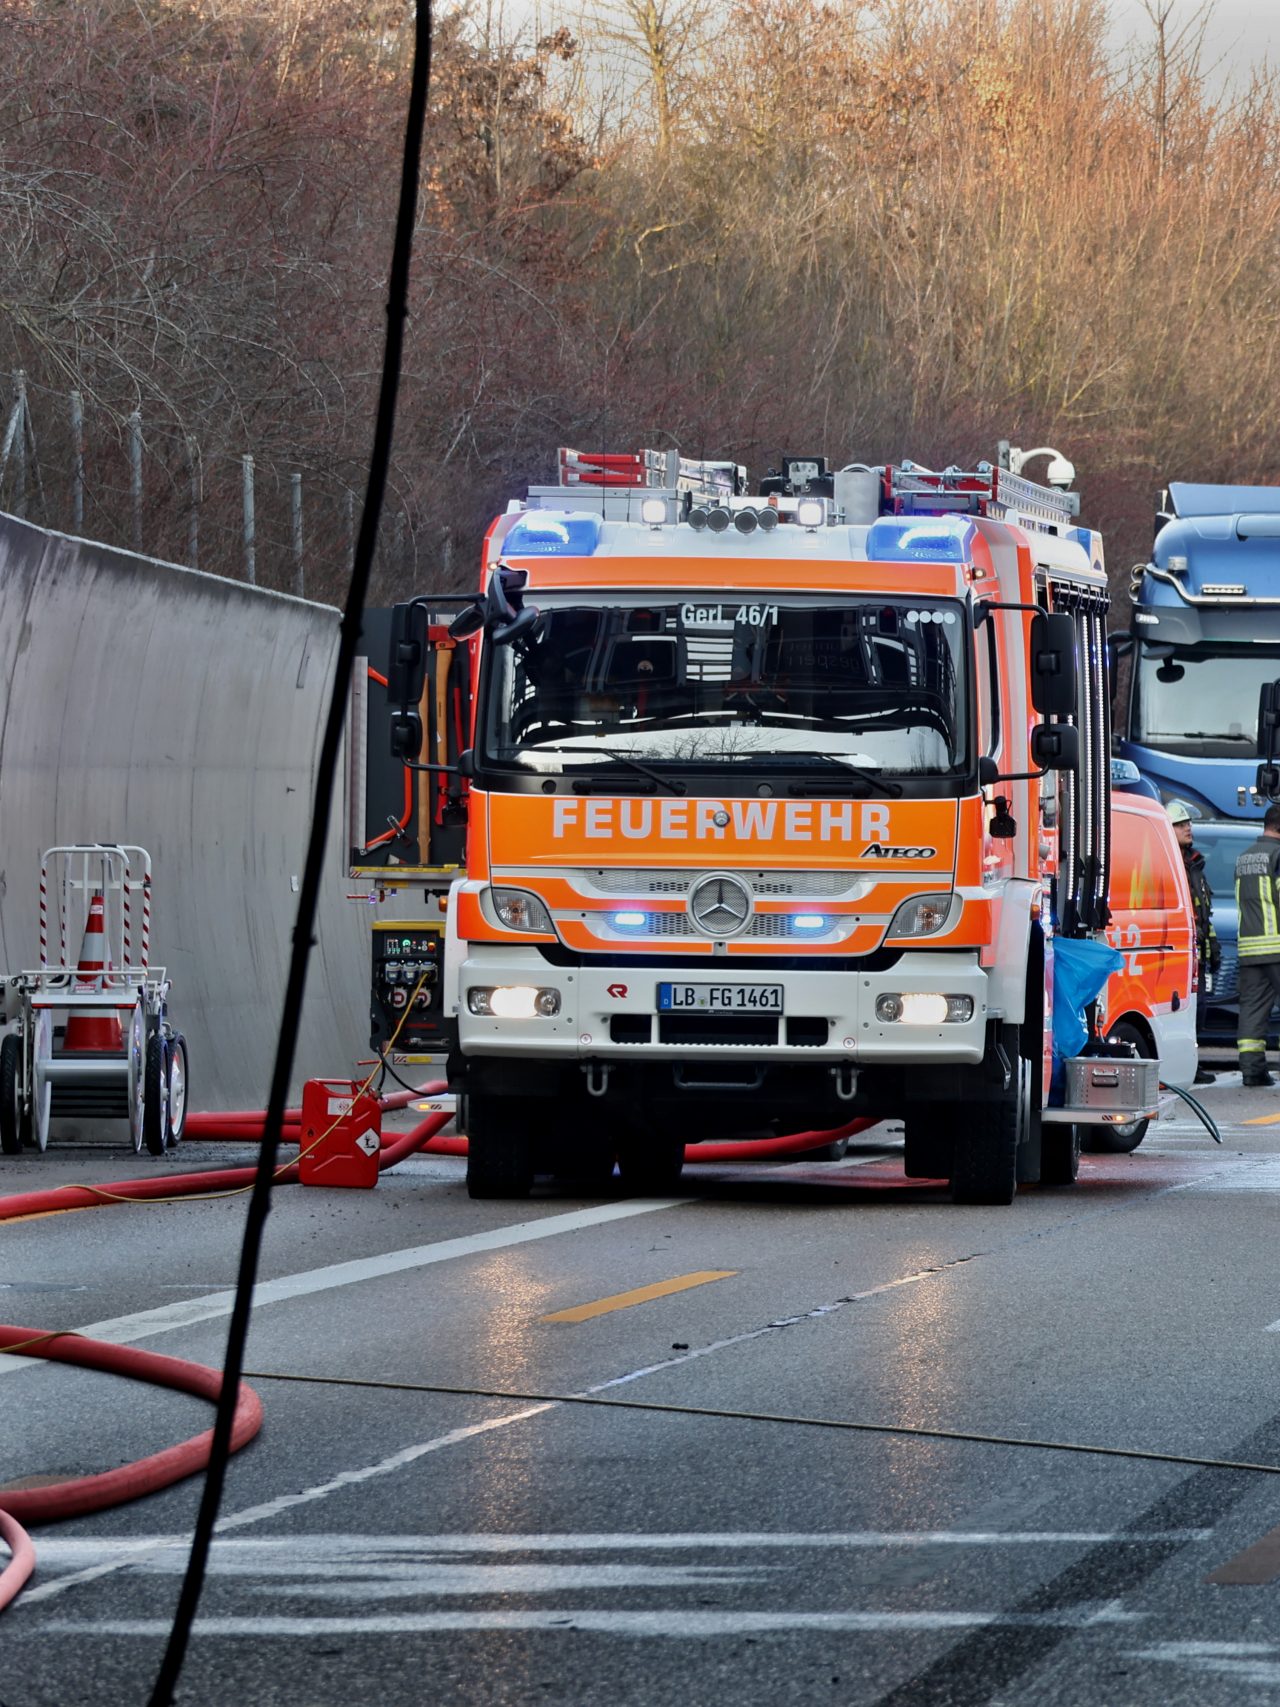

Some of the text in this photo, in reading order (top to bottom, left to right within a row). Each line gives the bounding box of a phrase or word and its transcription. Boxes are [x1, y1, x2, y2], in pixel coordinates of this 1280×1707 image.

[681, 605, 779, 627] Gerl. 46/1
[552, 799, 890, 842] FEUERWEHR
[673, 988, 781, 1008] LB FG 1461
